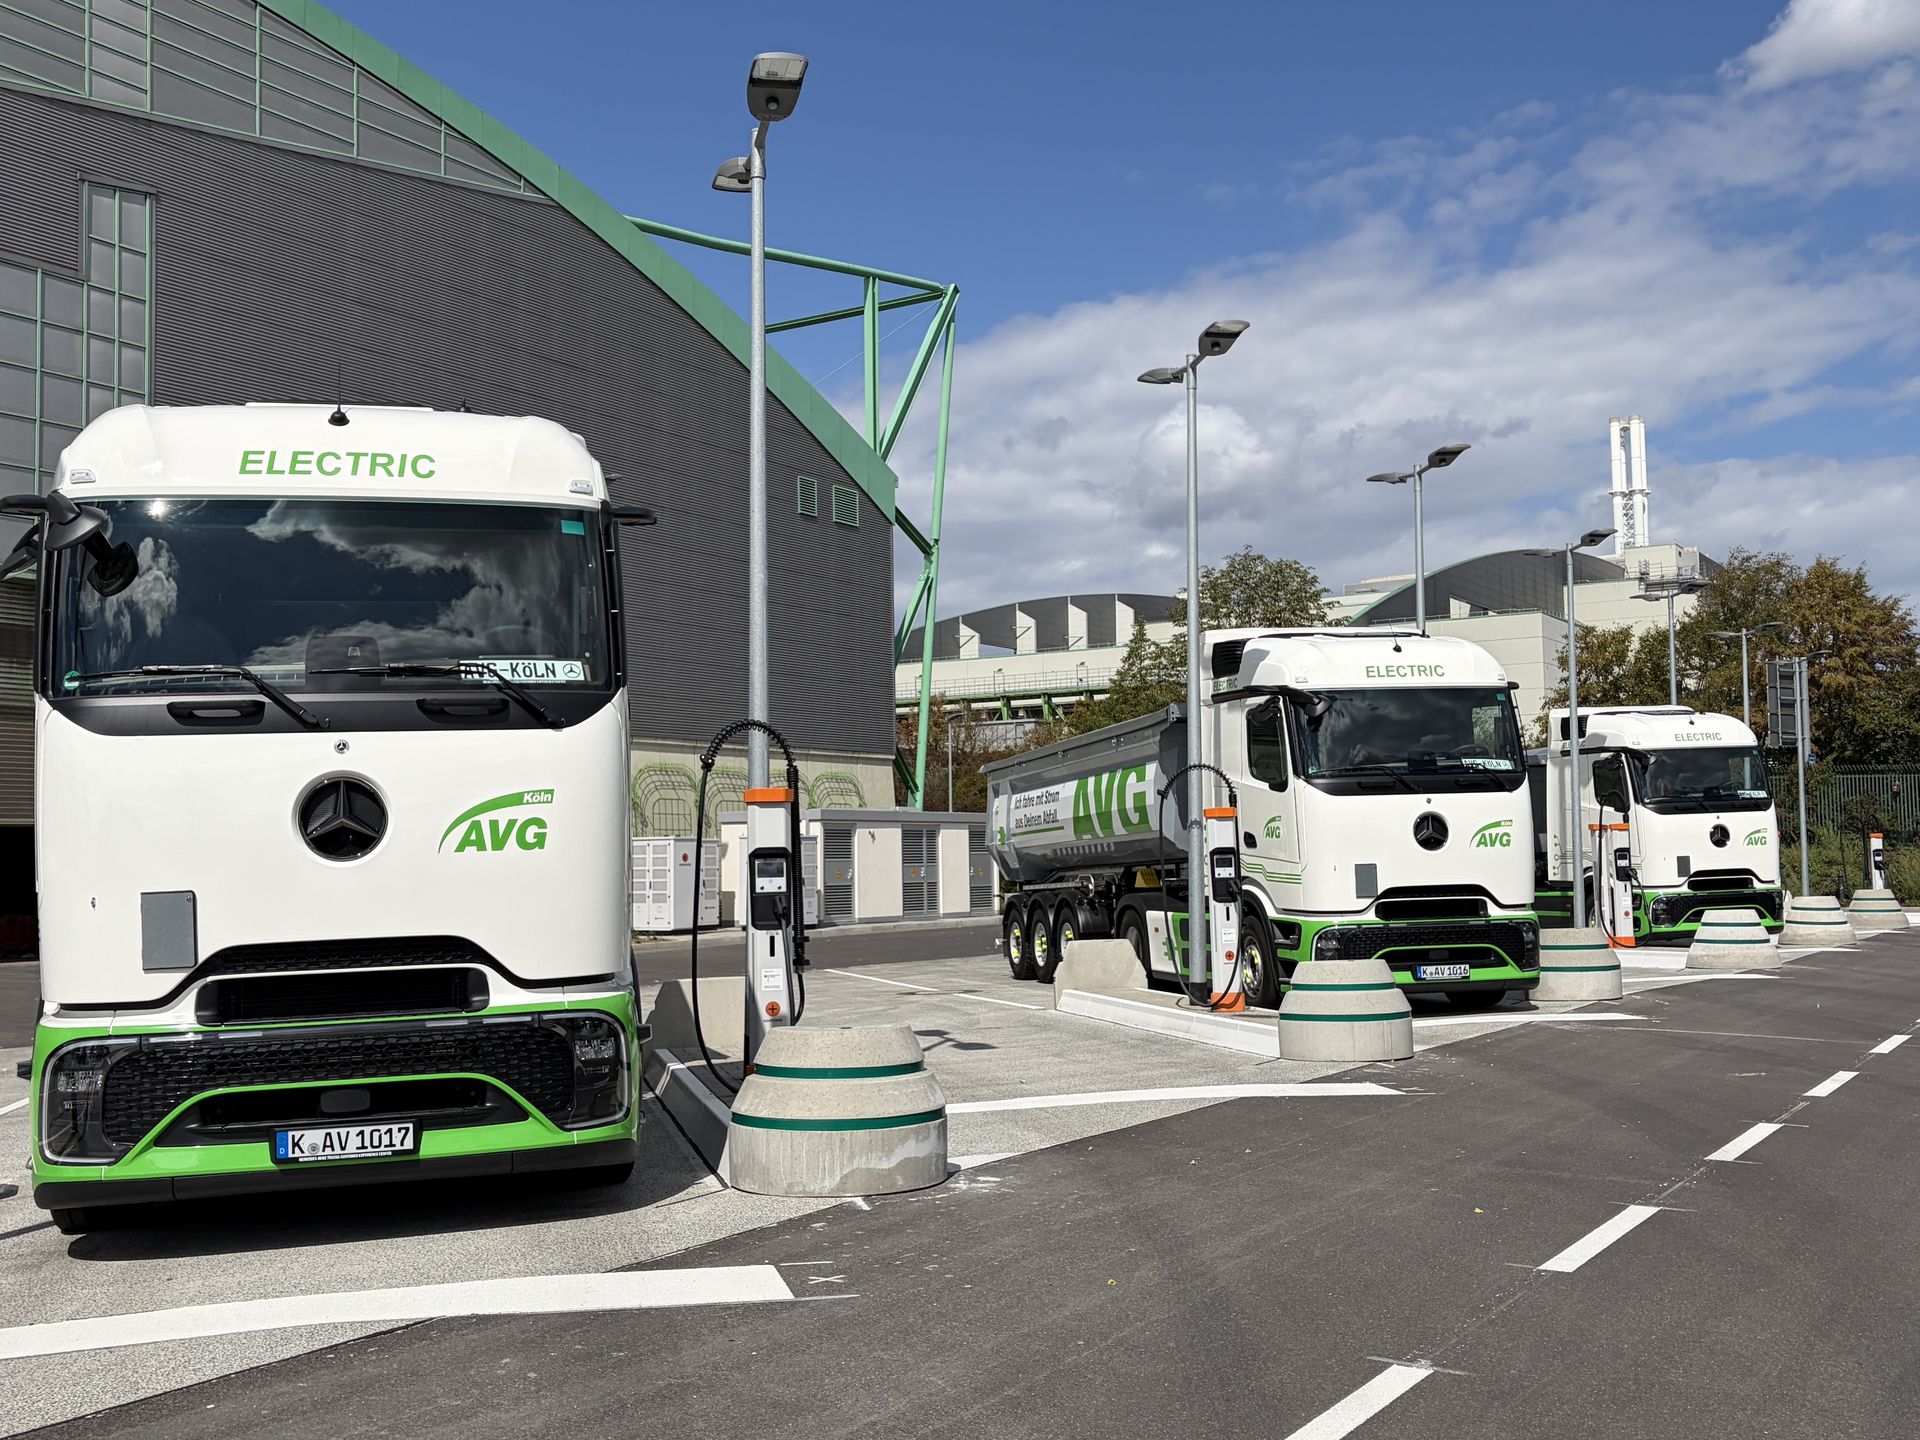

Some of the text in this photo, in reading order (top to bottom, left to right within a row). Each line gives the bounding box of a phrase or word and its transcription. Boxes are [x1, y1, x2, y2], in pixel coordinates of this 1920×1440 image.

[239, 450, 436, 479] ELECTRIC
[1365, 664, 1445, 678] ELECTRIC
[1212, 677, 1238, 692] ELECTRIC
[1674, 732, 1722, 742] ELECTRIC
[523, 791, 552, 803] Köln
[1072, 763, 1153, 840] AVG
[453, 816, 548, 853] AVG
[1265, 825, 1281, 839] AVG
[1476, 832, 1512, 848] AVG
[1746, 835, 1767, 846] AVG
[1422, 965, 1469, 977] K AV 1016
[279, 1126, 410, 1155] D K AV 1017
